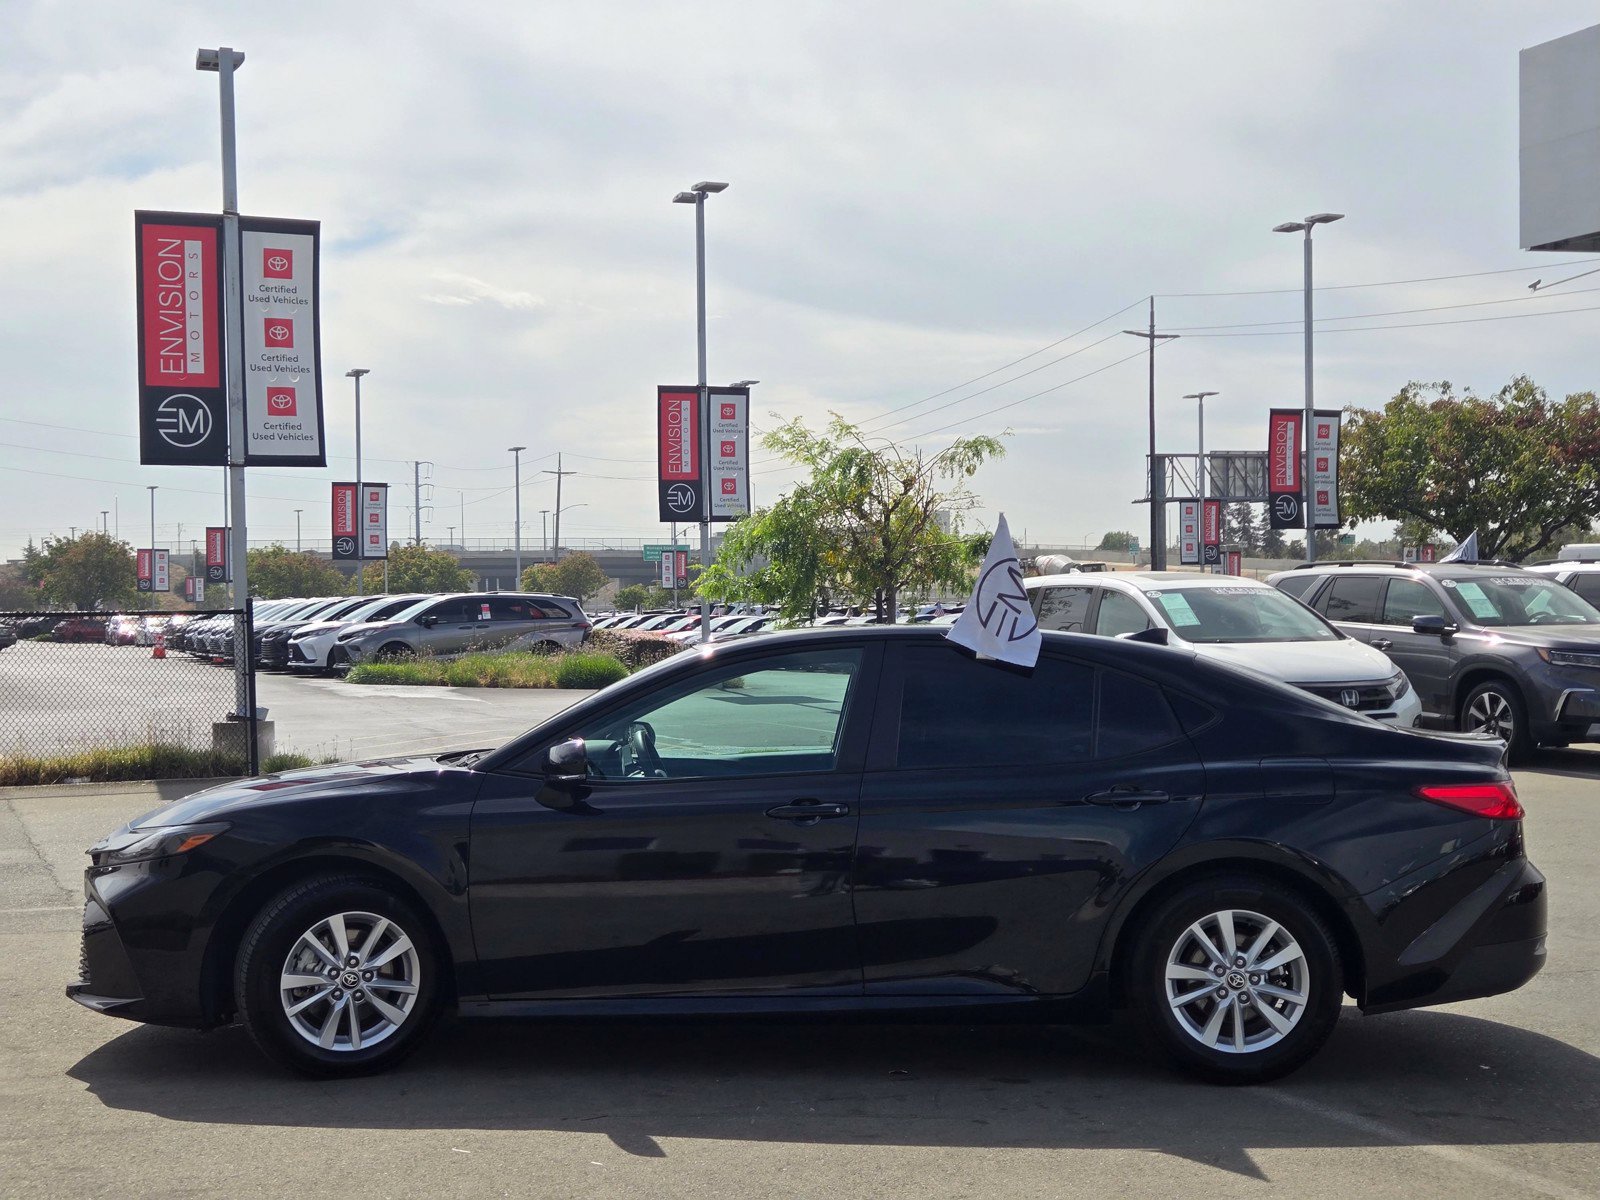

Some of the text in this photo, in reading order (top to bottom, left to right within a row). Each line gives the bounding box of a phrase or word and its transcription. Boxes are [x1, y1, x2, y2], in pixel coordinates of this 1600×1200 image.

[158, 238, 184, 374] ENVISION
[189, 252, 200, 363] MOTORS
[258, 284, 298, 294] Certified
[272, 296, 308, 305] Vehicles
[260, 354, 298, 362] Certified
[274, 365, 310, 373] Vehicles
[668, 400, 681, 473] ENVISION
[1276, 422, 1287, 486] ENVISION
